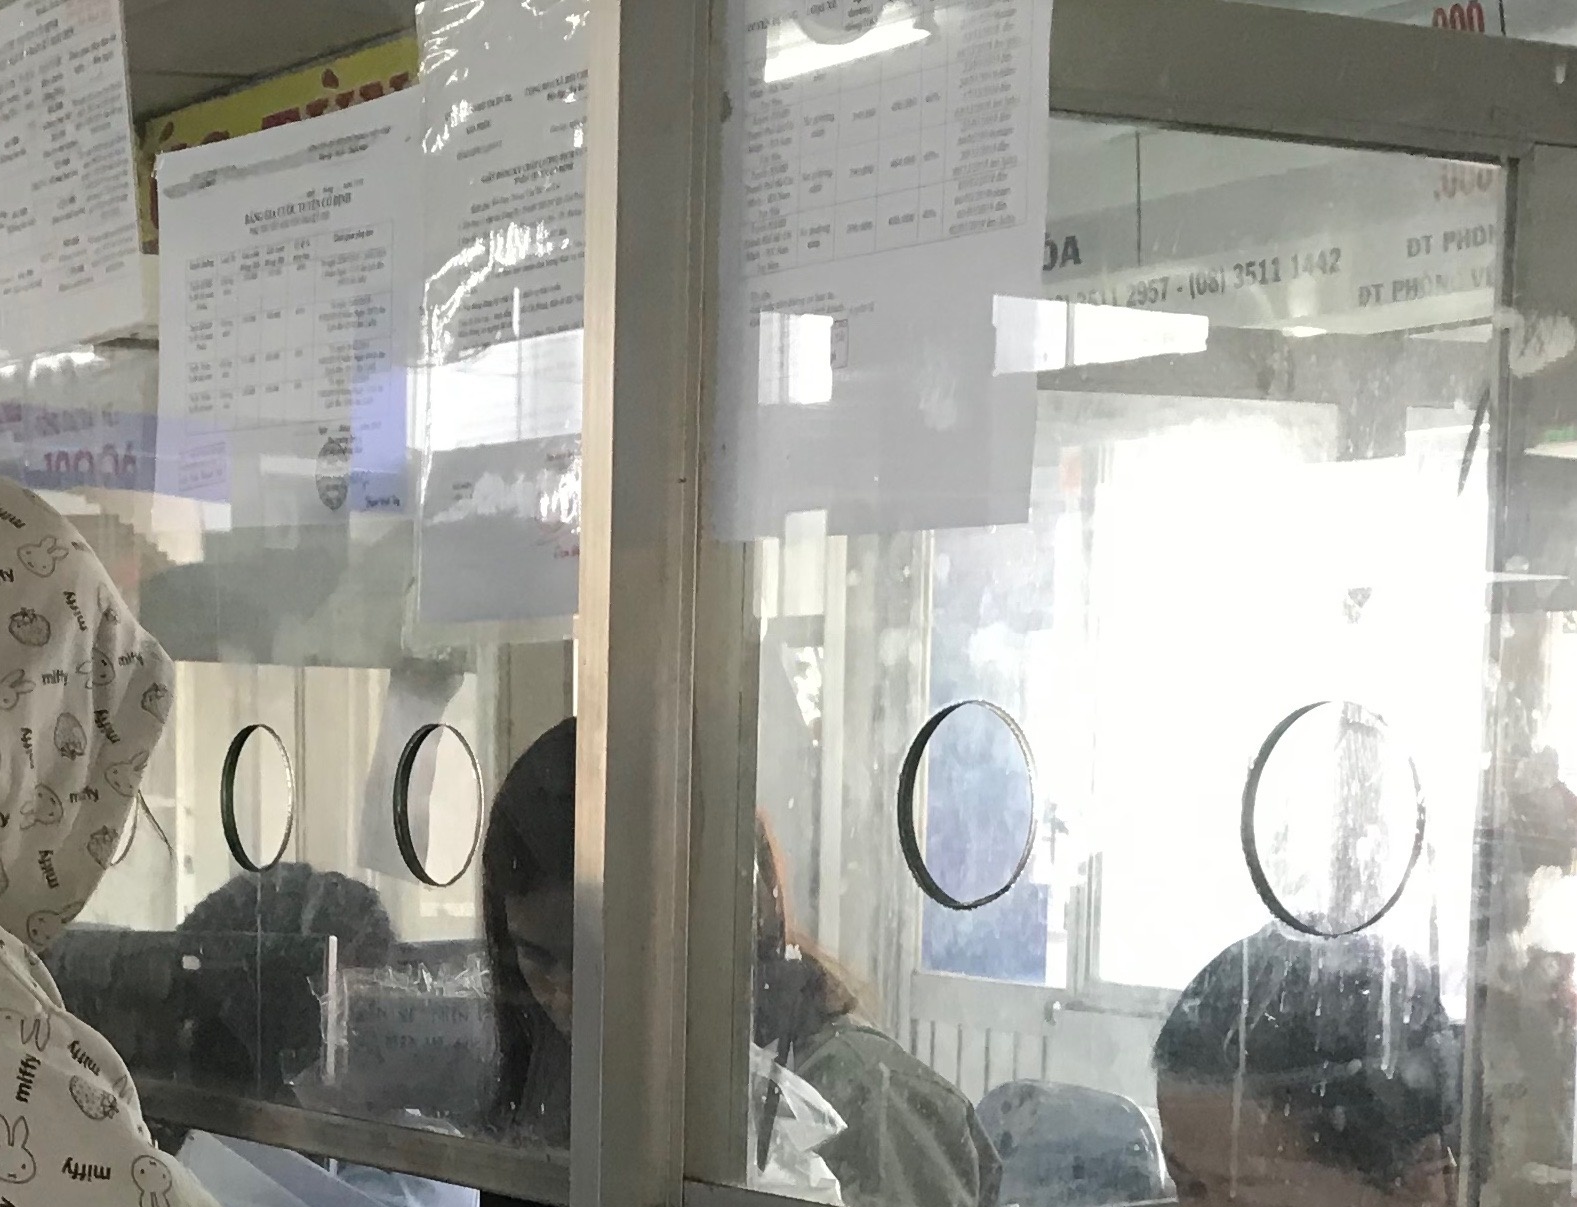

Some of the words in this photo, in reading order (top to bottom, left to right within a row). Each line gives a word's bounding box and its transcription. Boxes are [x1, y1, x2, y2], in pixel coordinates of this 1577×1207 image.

[1232, 257, 1282, 290] 3511
[38, 850, 59, 889] miffy
[67, 1040, 101, 1077] miffy
[15, 1053, 41, 1103] miffy
[61, 1156, 111, 1181] miffy
